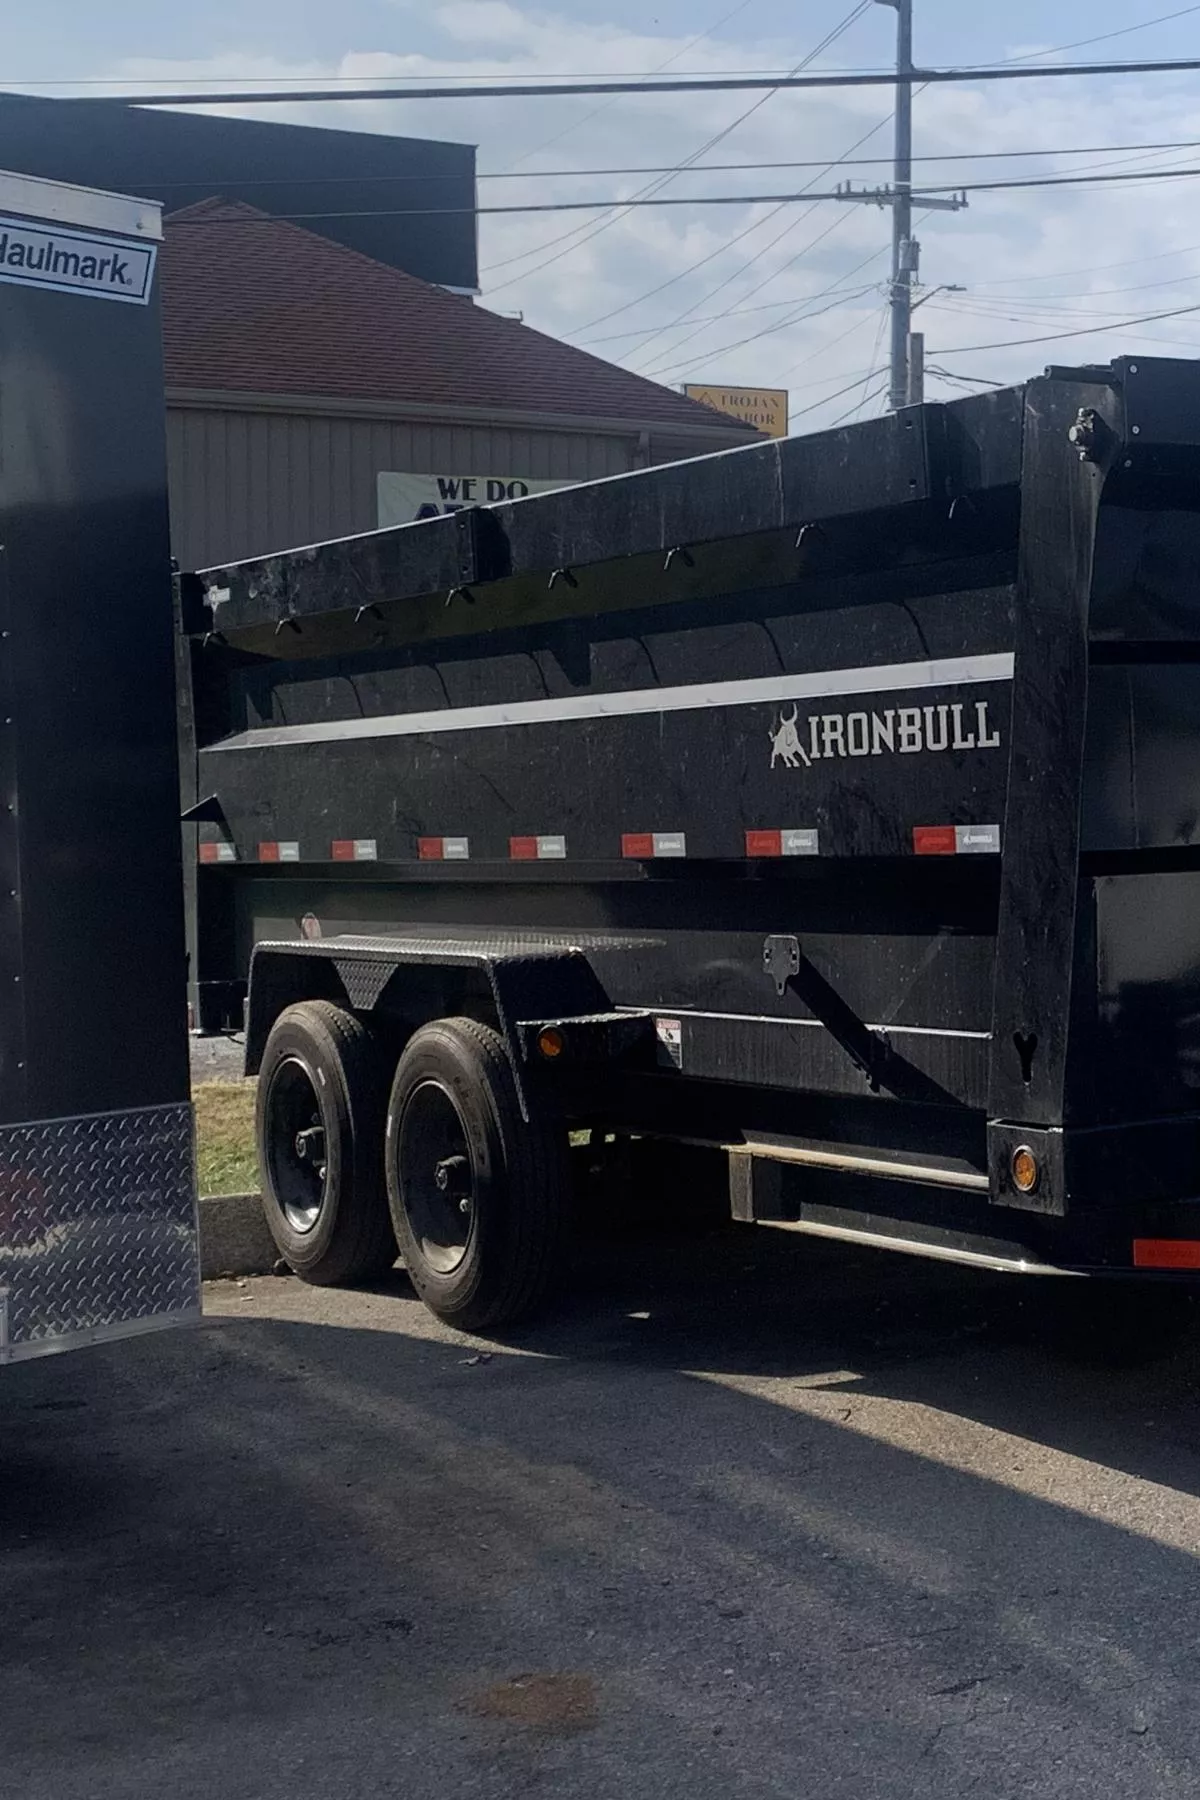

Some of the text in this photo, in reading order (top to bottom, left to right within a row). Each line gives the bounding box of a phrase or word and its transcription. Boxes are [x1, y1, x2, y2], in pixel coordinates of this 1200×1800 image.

[437, 478, 528, 501] WE DO
[808, 701, 1000, 759] IRONBULL
